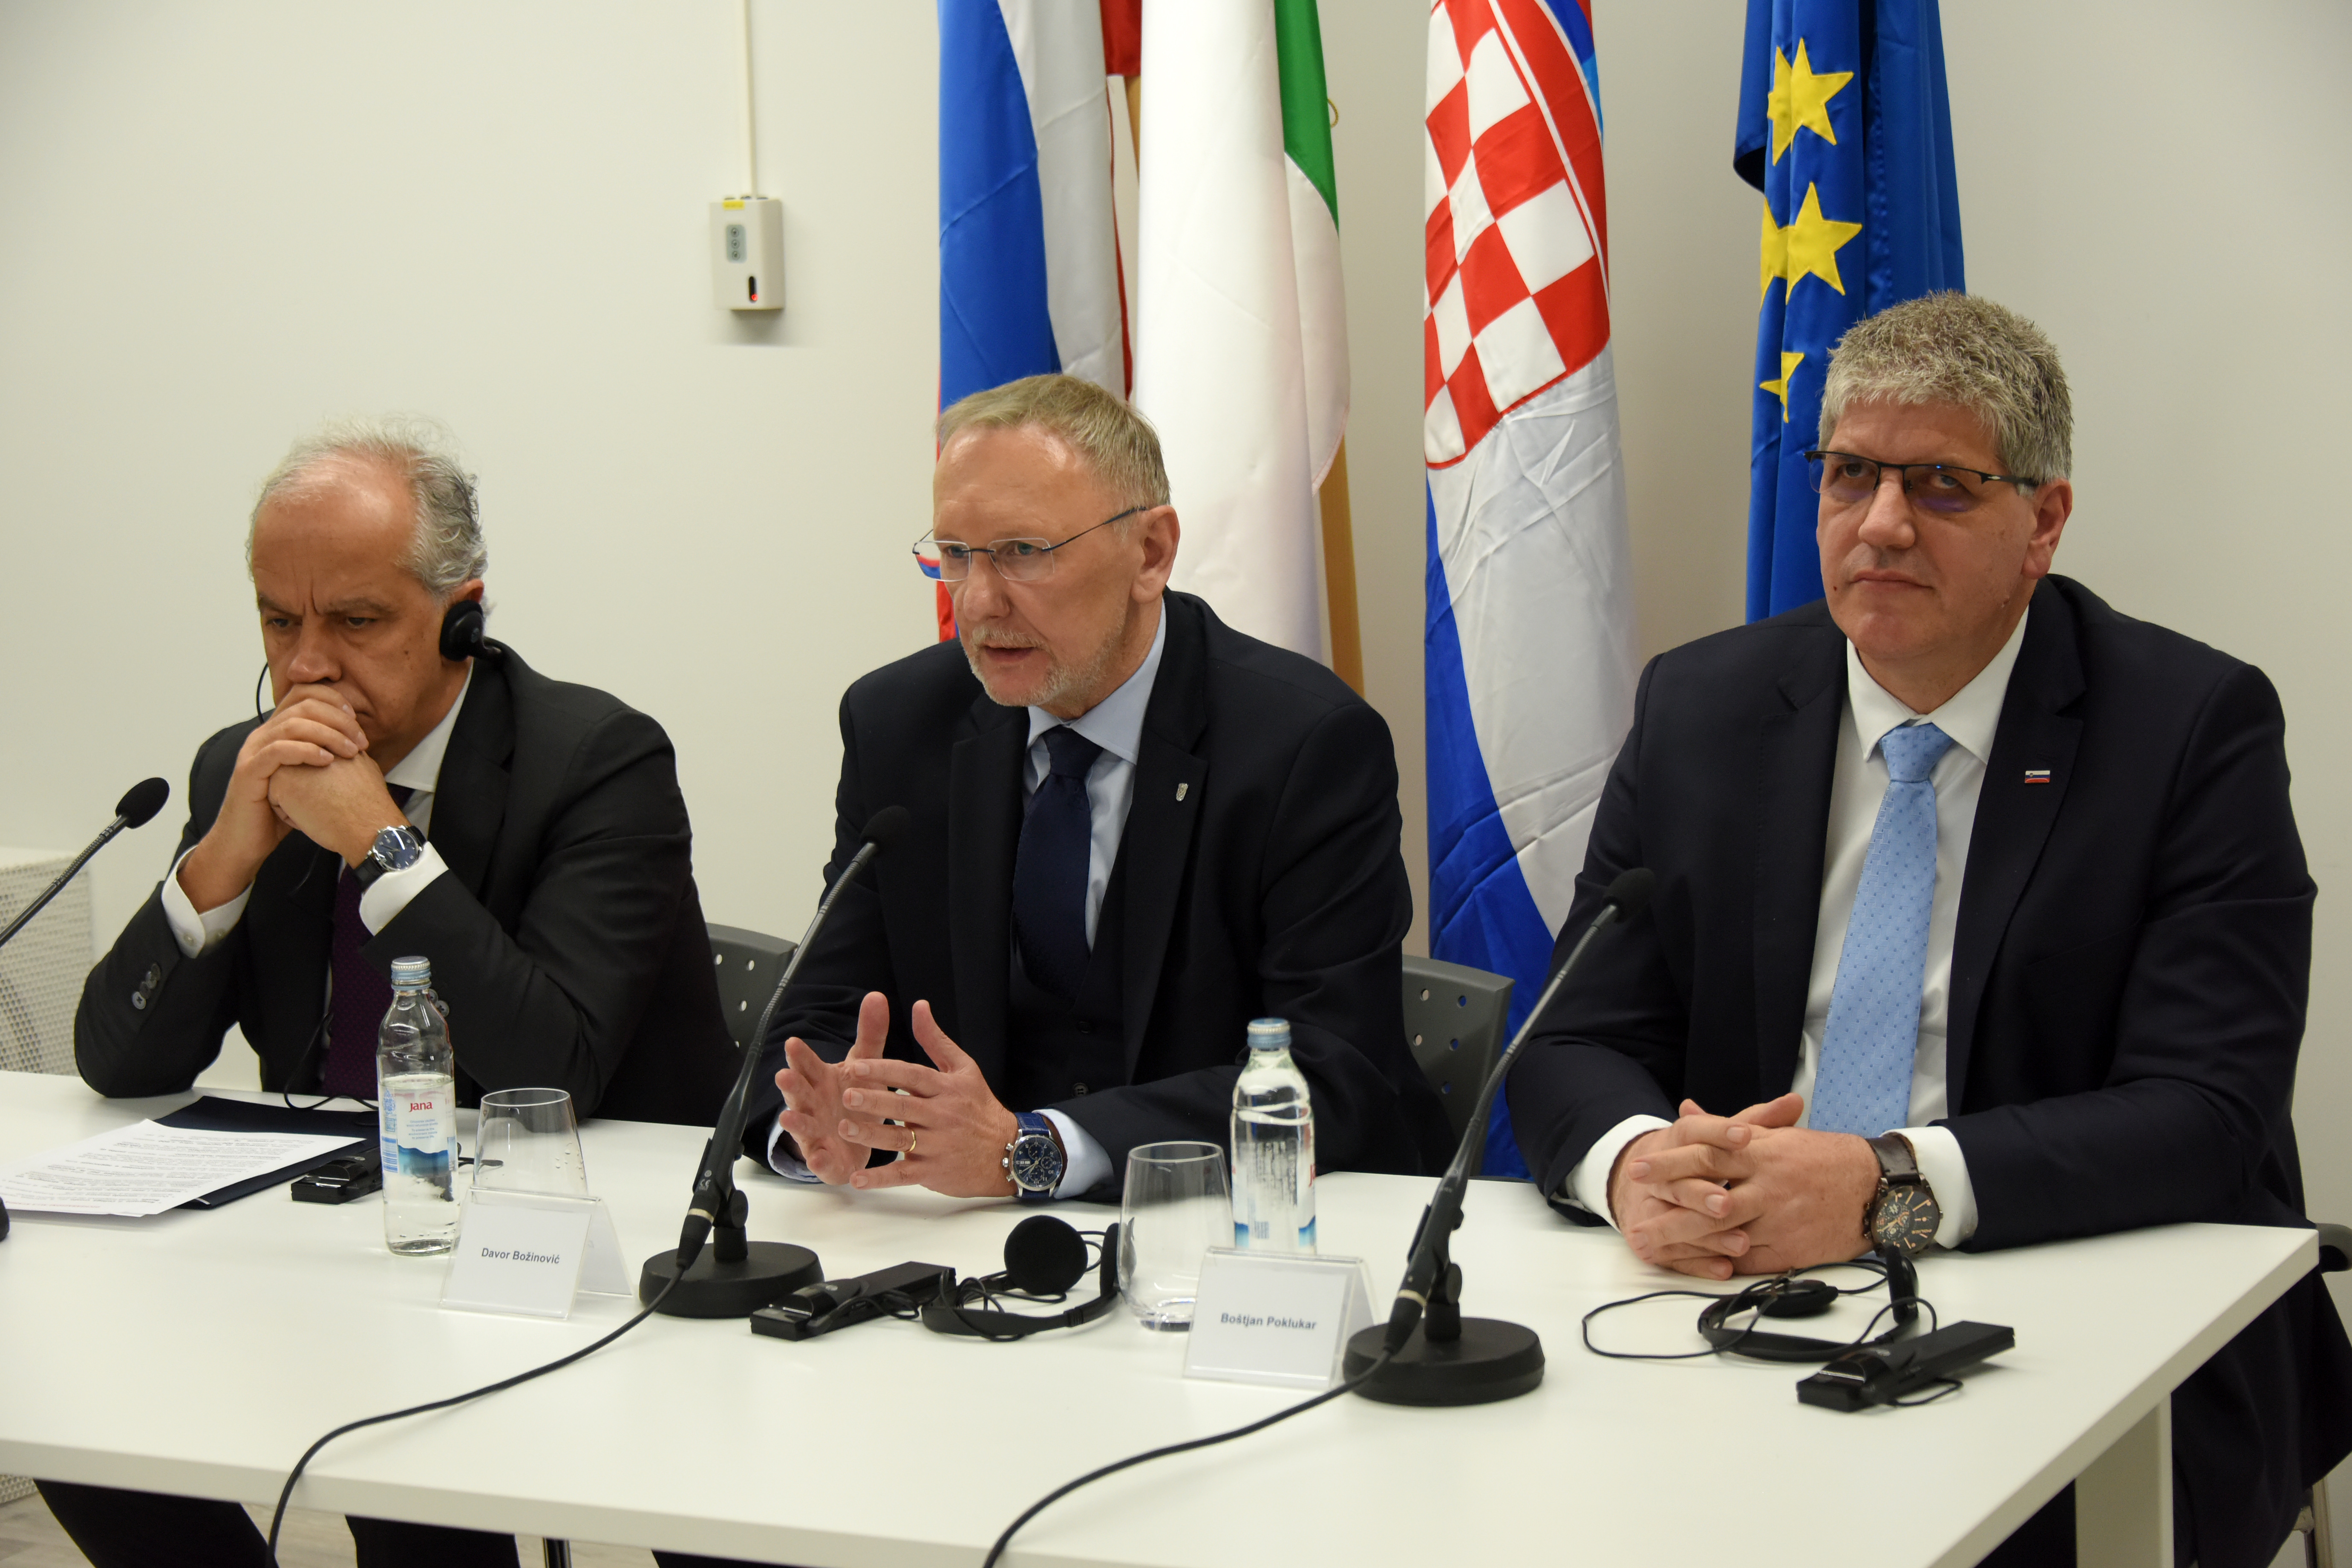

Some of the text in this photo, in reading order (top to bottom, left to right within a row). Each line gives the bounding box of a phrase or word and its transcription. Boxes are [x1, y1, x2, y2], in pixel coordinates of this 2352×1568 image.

[481, 1248, 560, 1264] Davor Božinović
[1221, 1312, 1317, 1329] Boštjan Poklukar
